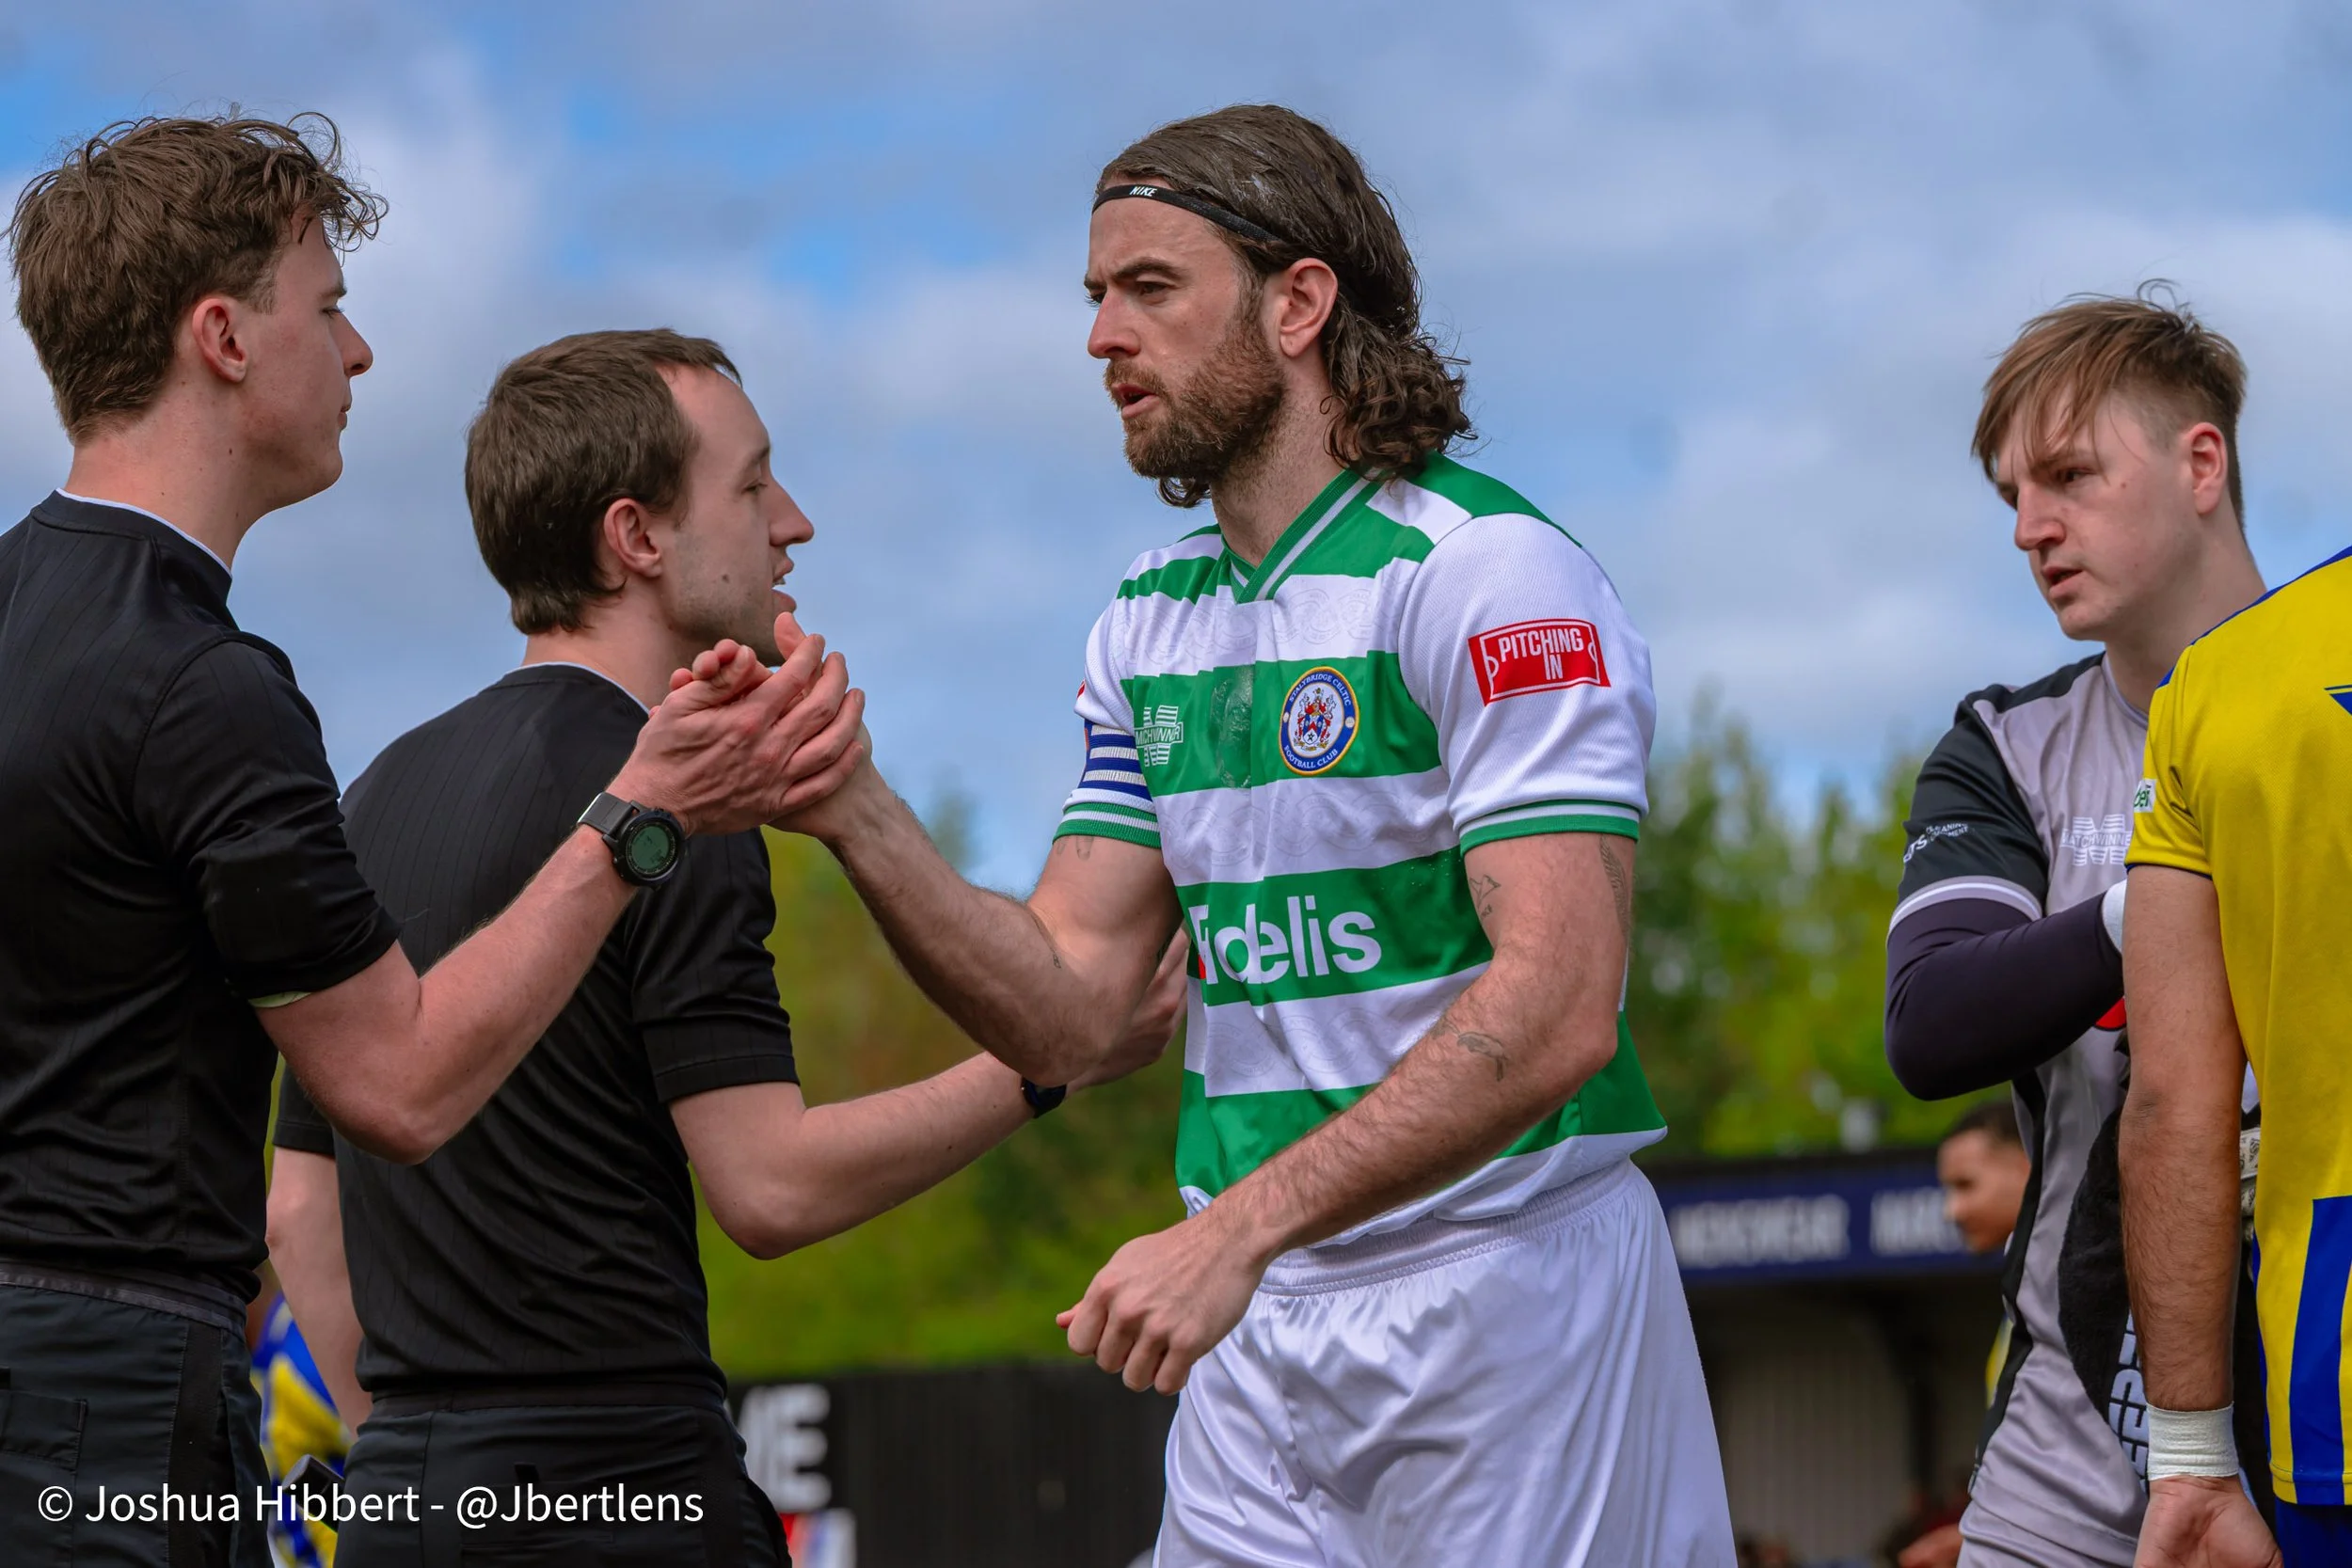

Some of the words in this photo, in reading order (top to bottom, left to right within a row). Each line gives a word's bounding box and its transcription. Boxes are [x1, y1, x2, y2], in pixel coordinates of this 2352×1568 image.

[1129, 186, 1157, 197] NIKE
[1498, 627, 1584, 663] PITCHING
[1544, 653, 1564, 680] IN
[1289, 673, 1332, 703] STALYBRIDGE
[1332, 678, 1351, 706] CELTIC
[1284, 745, 1316, 768] FOOTBALL
[1317, 749, 1338, 767] CLUB
[2061, 829, 2132, 848] MATCHWINNE
